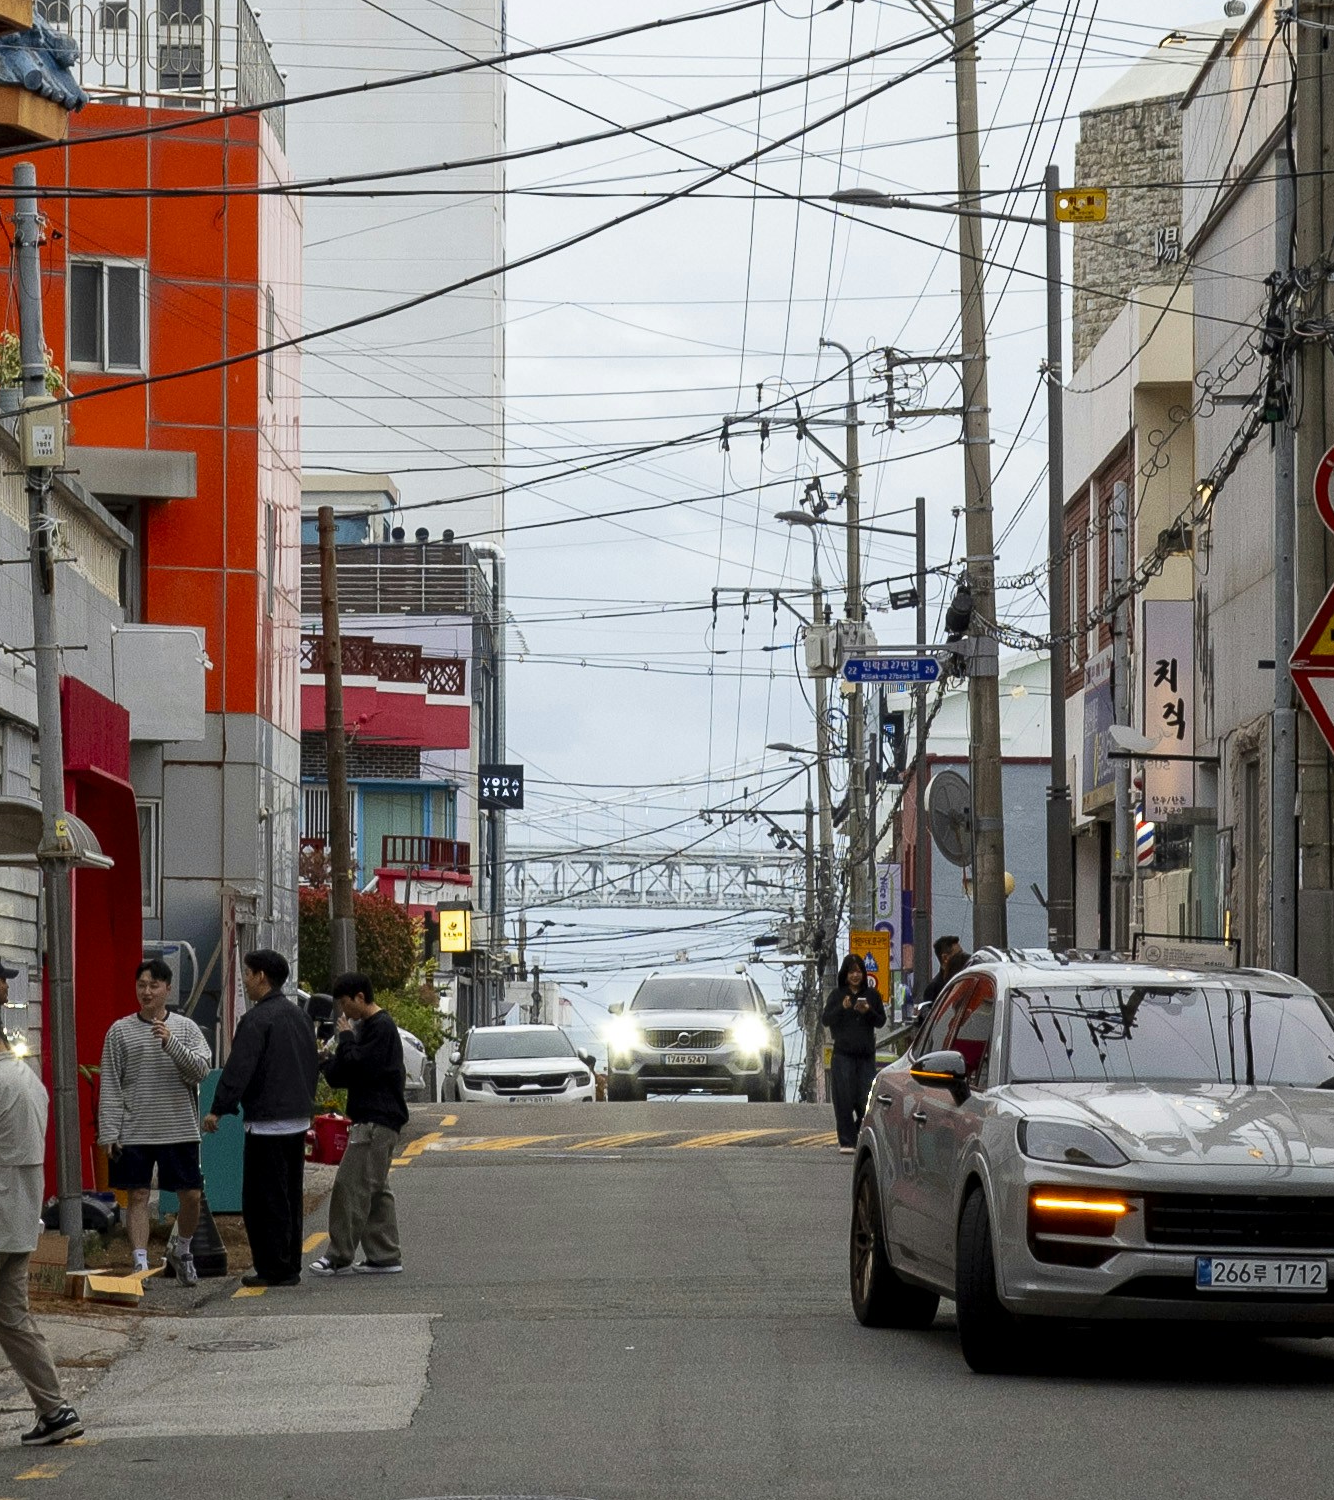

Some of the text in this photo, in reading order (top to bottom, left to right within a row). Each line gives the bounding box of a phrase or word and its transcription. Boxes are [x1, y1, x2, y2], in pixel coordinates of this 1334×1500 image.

[847, 667, 858, 676] 22
[925, 665, 935, 674] 26
[482, 787, 520, 797] STAY
[1214, 1262, 1322, 1285] 266루 1712
